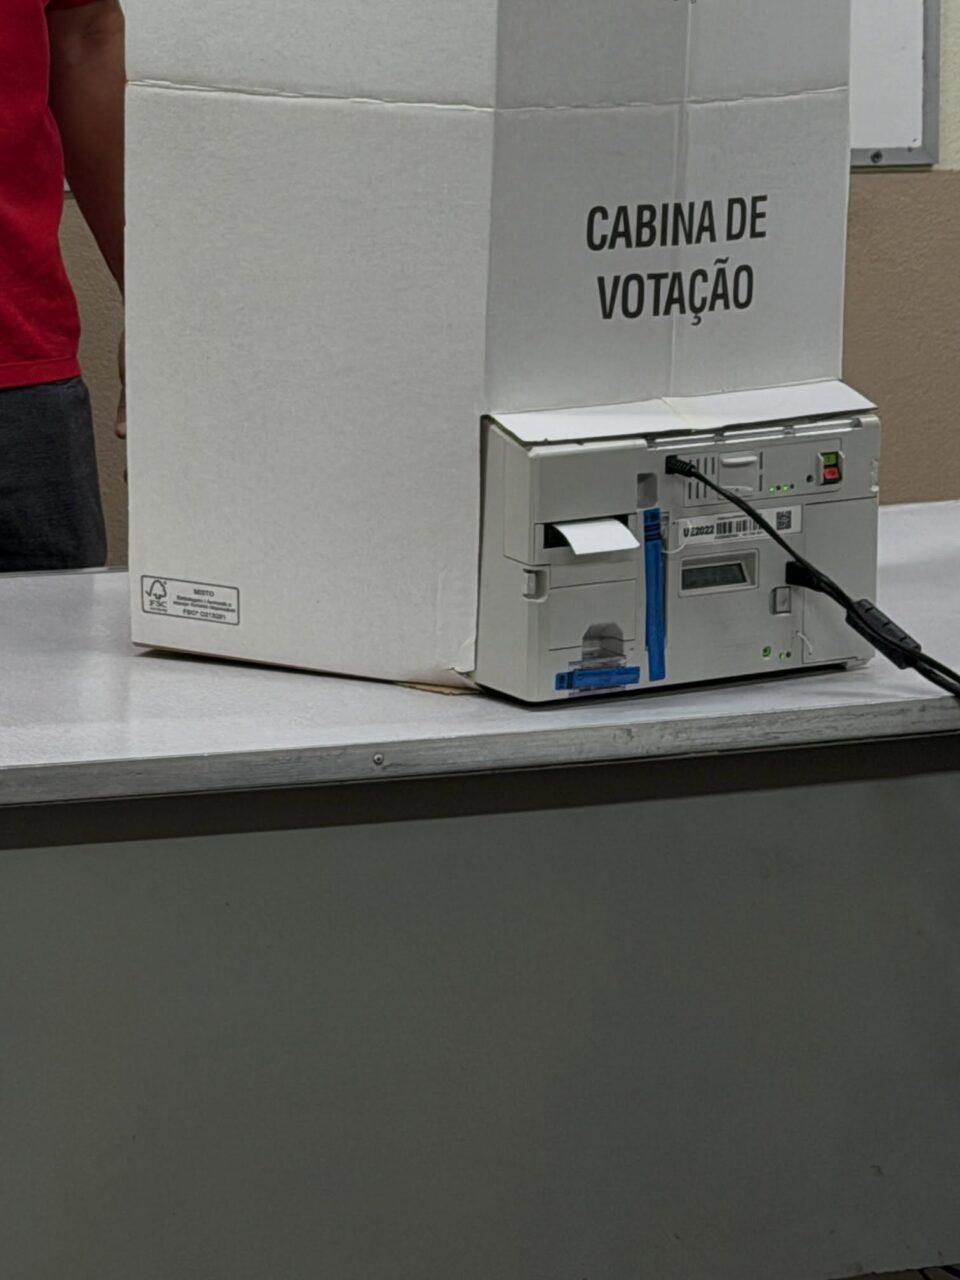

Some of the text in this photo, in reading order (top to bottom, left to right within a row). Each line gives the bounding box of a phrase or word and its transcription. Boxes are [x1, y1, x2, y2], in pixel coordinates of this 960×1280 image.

[586, 194, 768, 251] CABINA DE
[597, 256, 754, 326] VOTAÇÃO
[683, 524, 714, 538] UE2022
